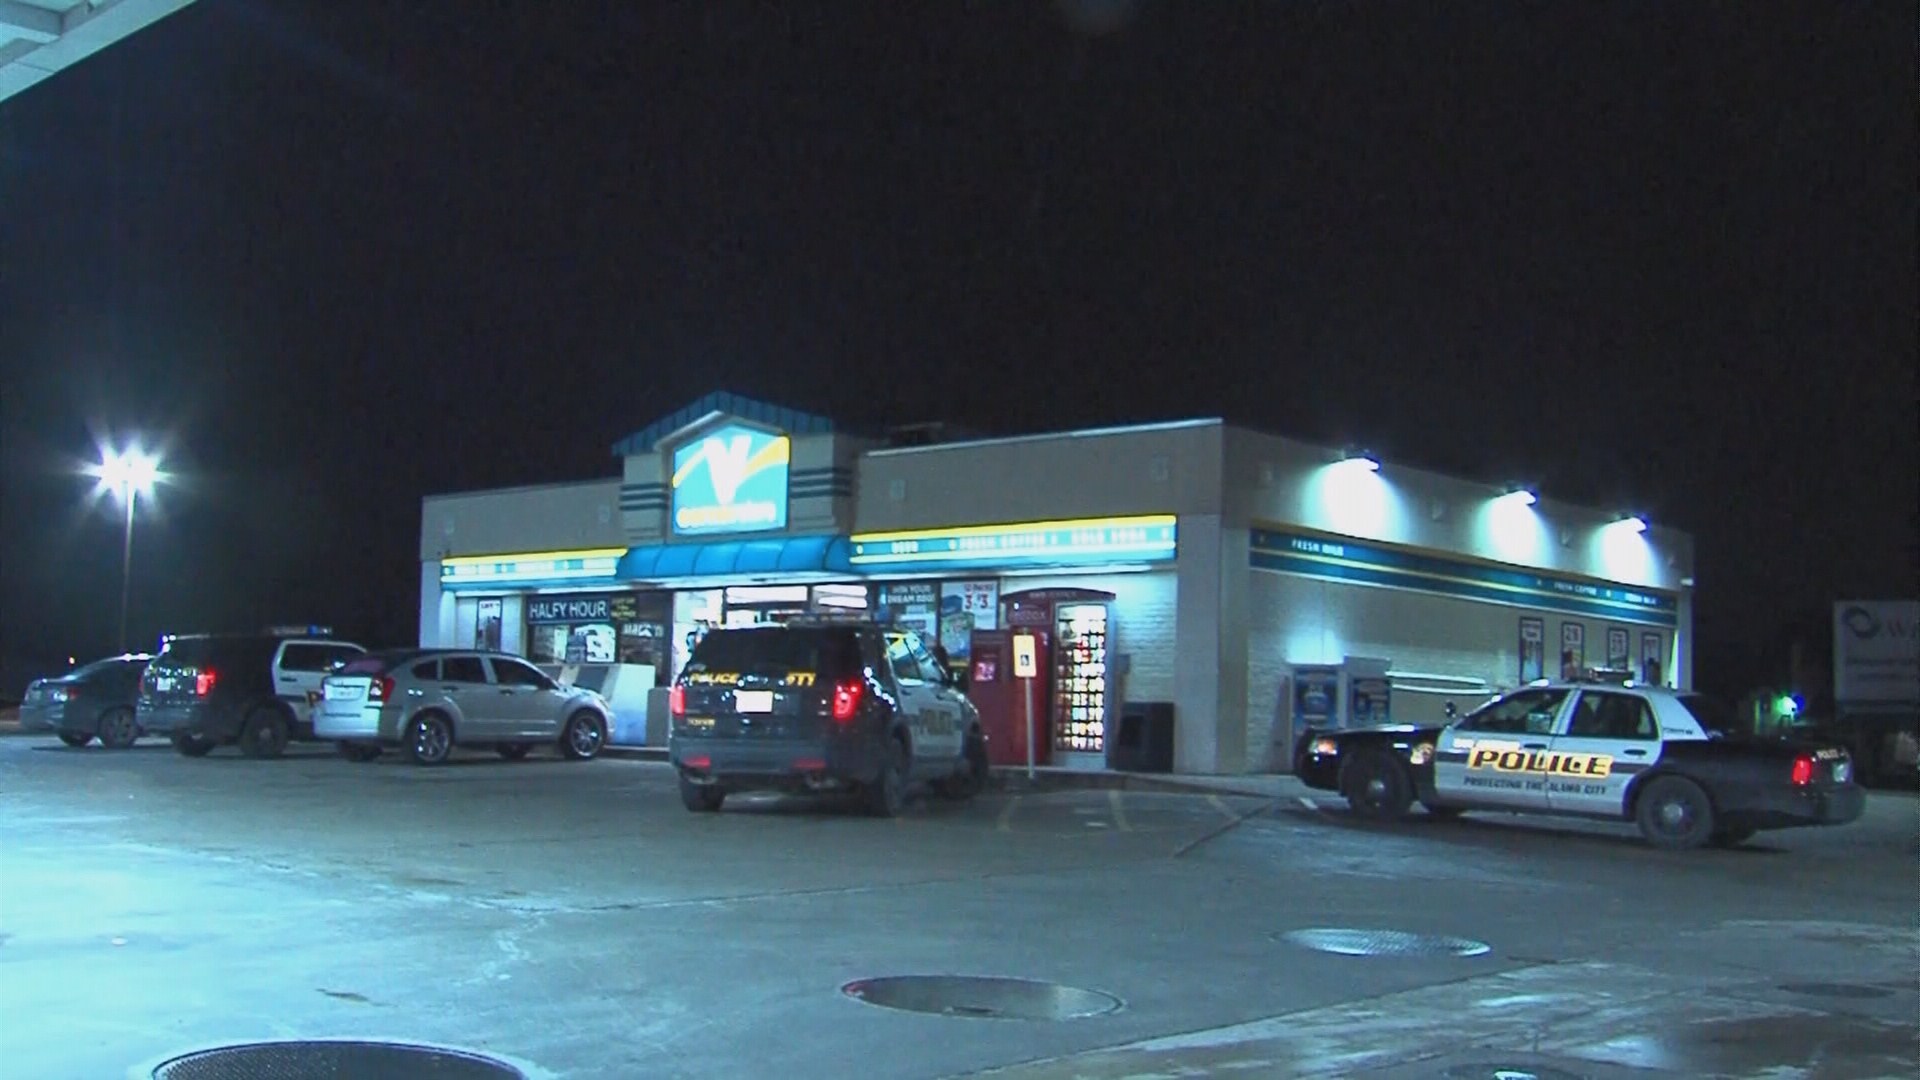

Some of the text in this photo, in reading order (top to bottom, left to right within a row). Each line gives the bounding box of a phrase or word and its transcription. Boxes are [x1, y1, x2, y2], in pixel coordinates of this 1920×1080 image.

[569, 600, 607, 618] HOUR
[688, 672, 740, 685] POLICE
[1470, 748, 1612, 777] POLICE
[1463, 774, 1523, 790] PROTECTING
[1526, 779, 1544, 791] THE
[1583, 784, 1607, 796] CITY
